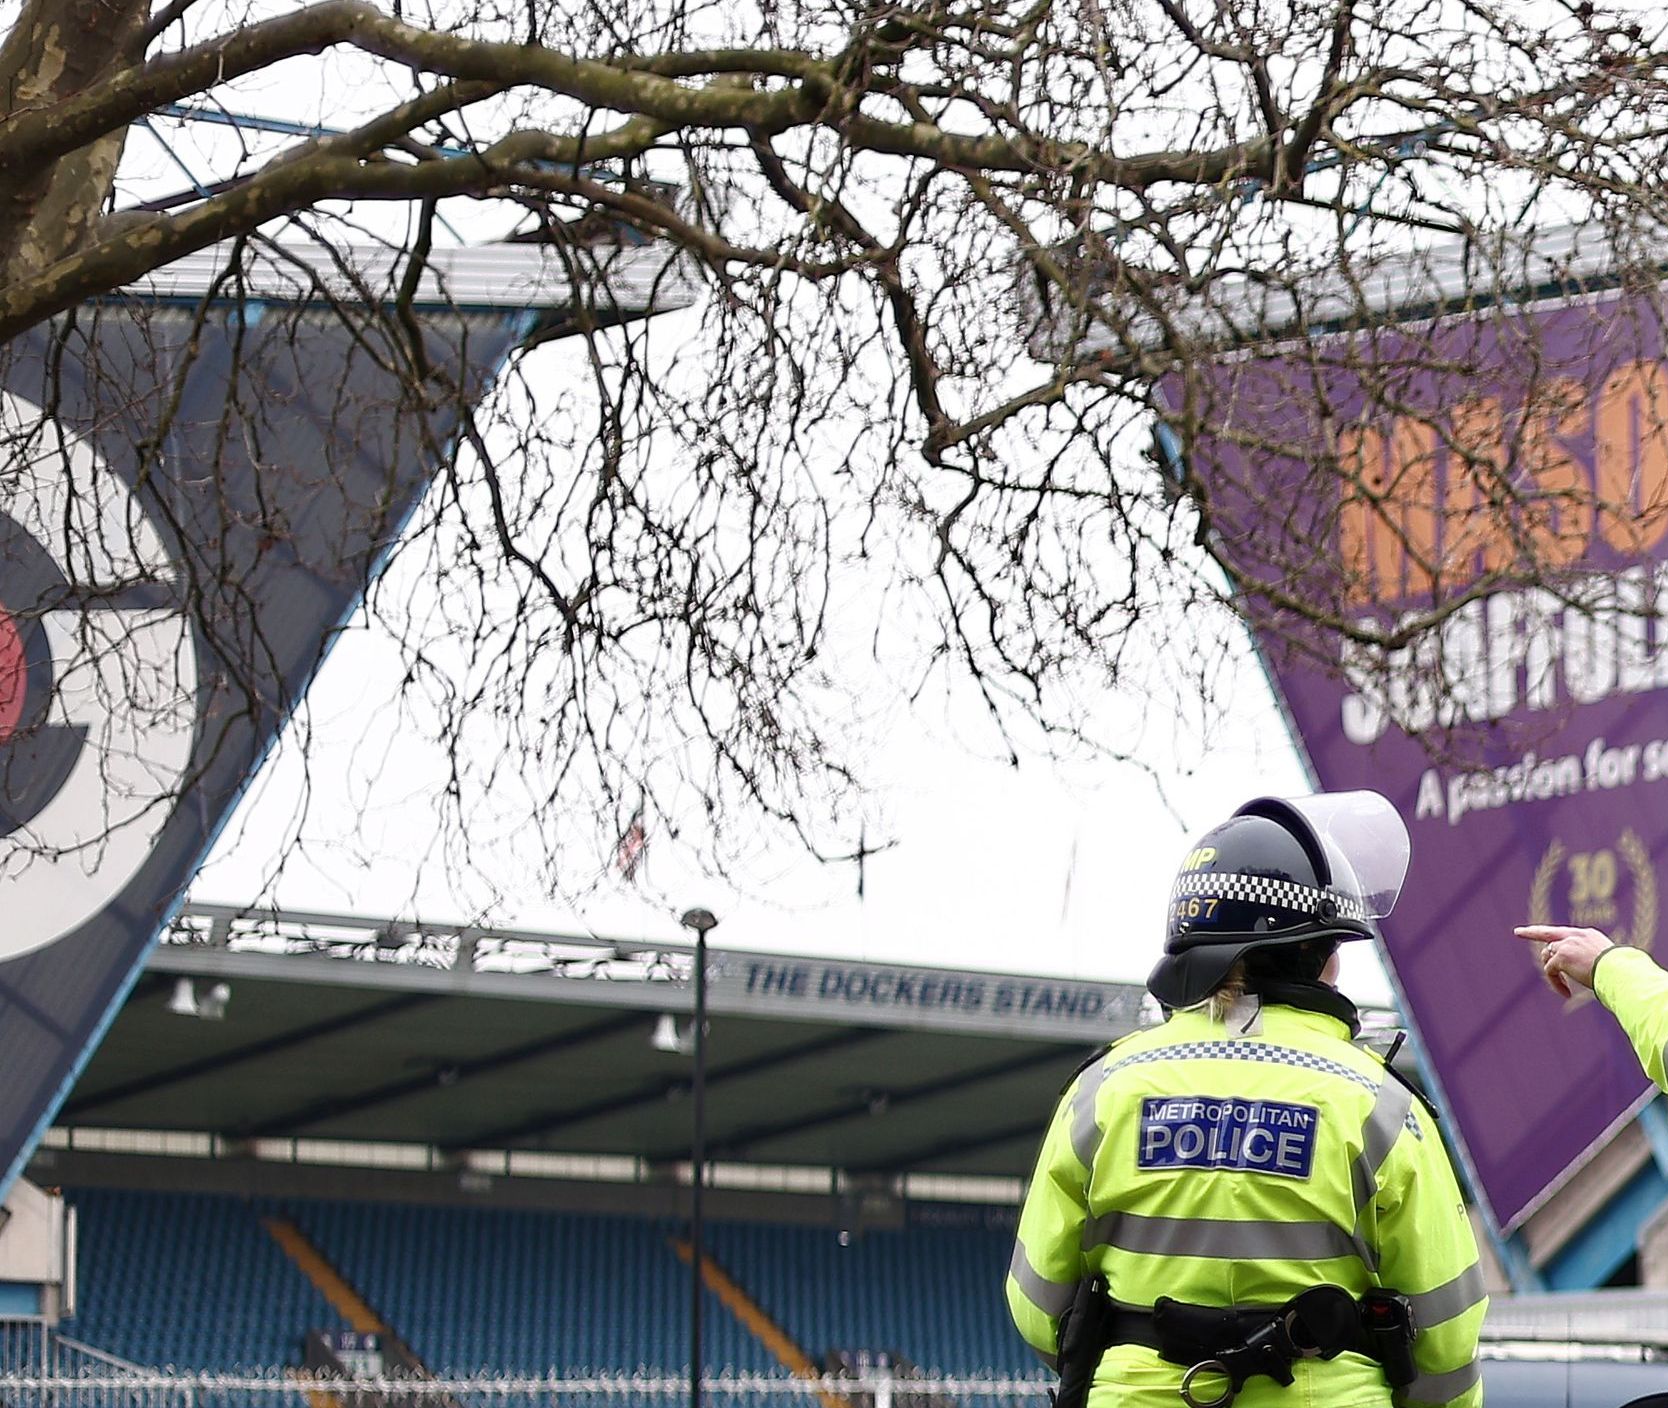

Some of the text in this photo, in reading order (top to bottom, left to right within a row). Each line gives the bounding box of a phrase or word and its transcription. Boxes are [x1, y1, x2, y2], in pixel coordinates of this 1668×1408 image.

[1415, 768, 1444, 821] A
[1447, 752, 1583, 827] passion
[1585, 737, 1638, 792] for
[1182, 846, 1217, 873] MP
[1567, 850, 1617, 904] 30
[746, 962, 1102, 1021] THE DOCKERS STAND
[1148, 1103, 1310, 1129] METROPOLITAN
[1145, 1125, 1307, 1168] POLICE
